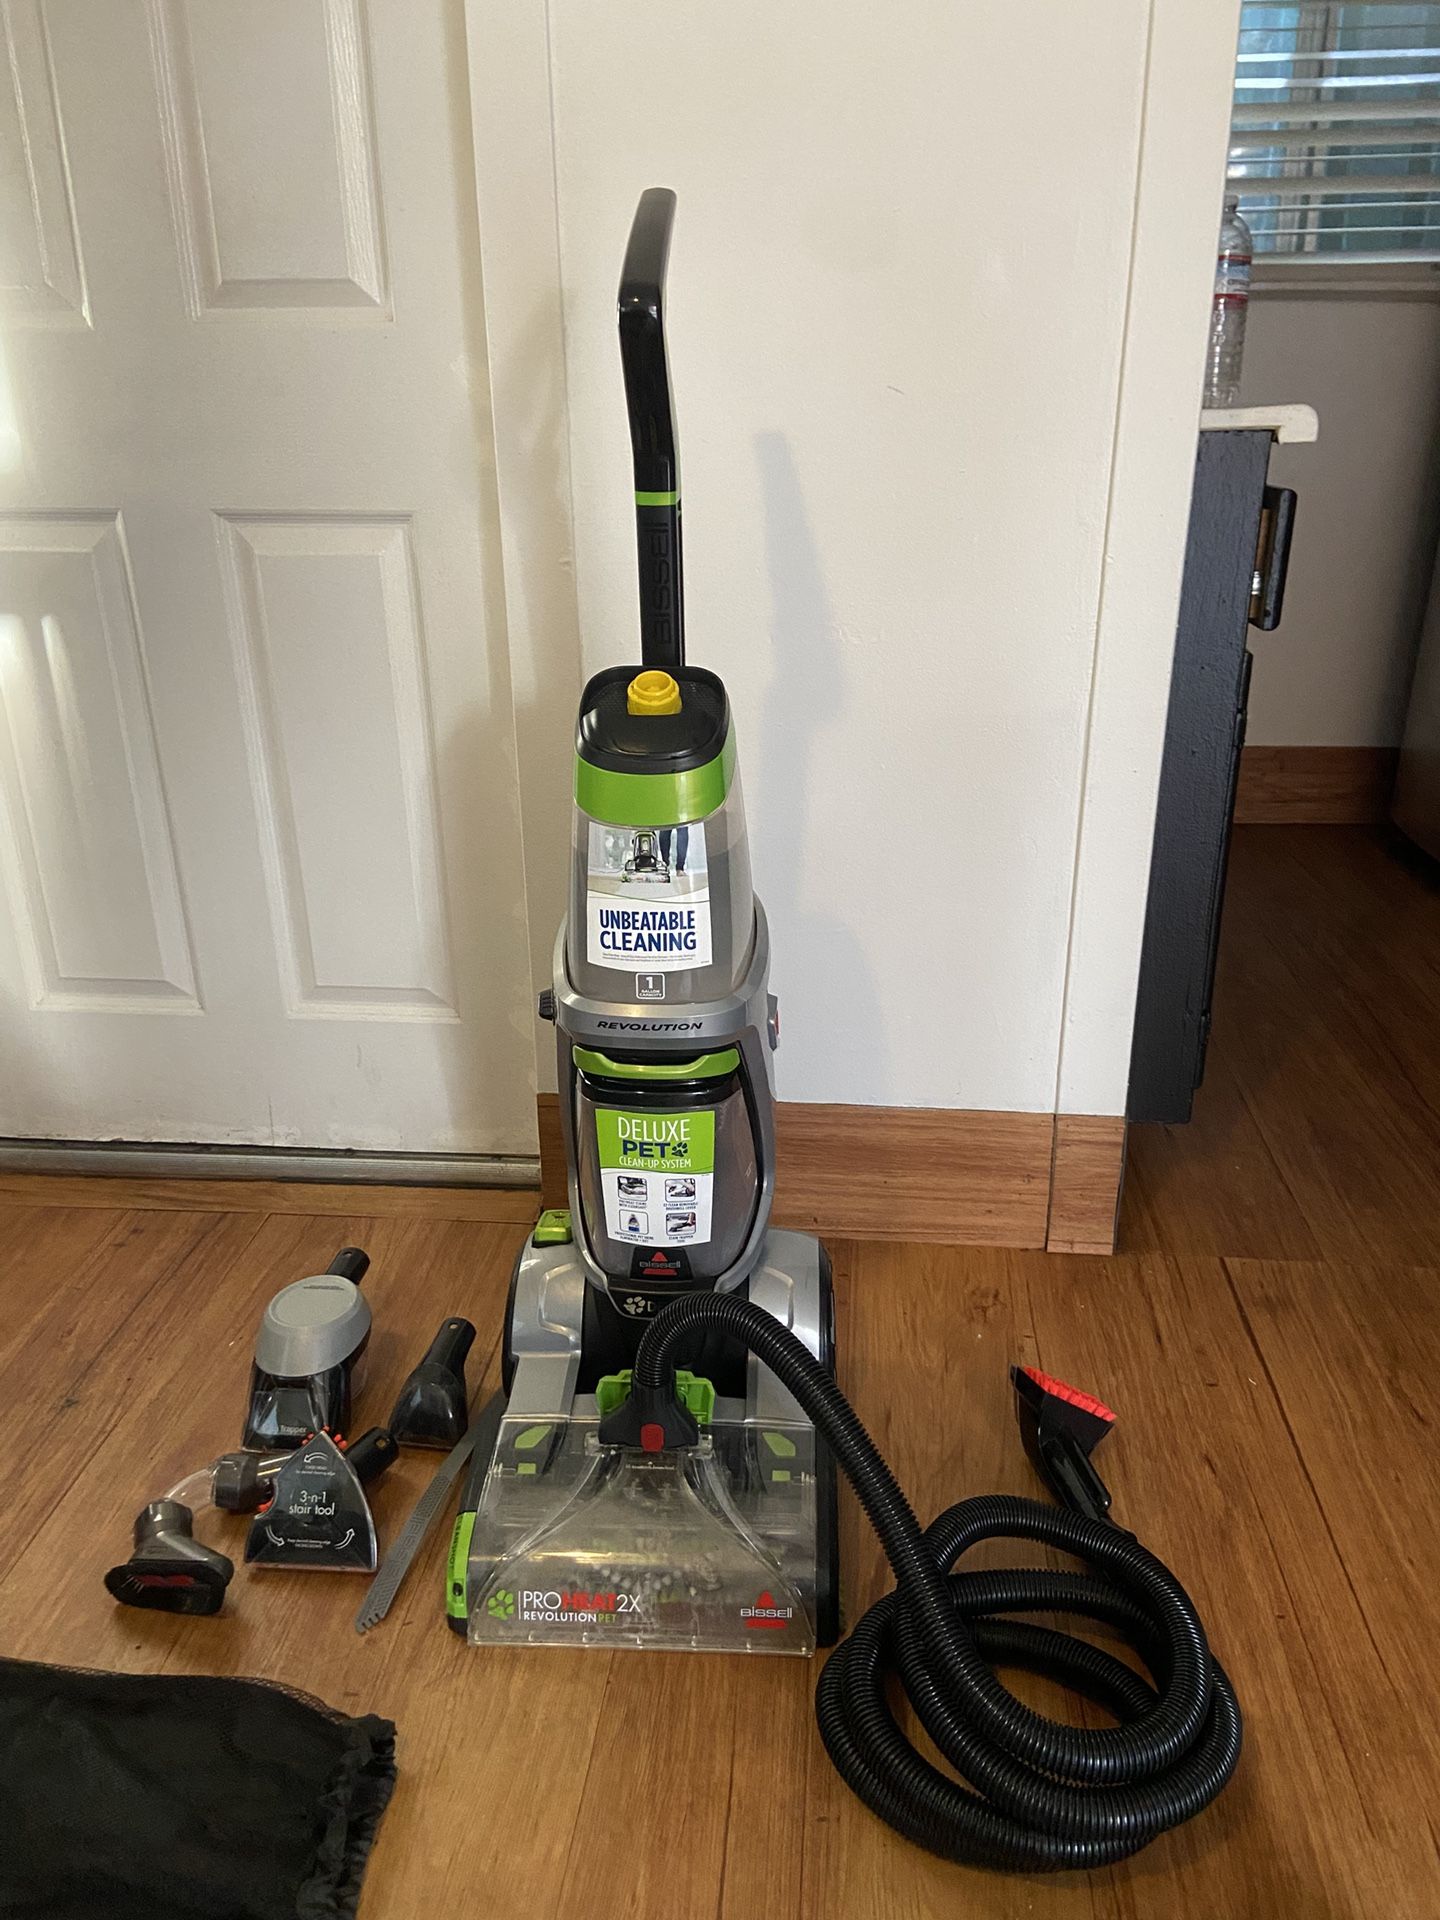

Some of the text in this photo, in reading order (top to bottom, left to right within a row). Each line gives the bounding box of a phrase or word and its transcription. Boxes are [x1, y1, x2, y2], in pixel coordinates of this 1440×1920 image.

[599, 908, 696, 931] UNBEATABLE
[599, 930, 697, 952] CLEANING
[645, 976, 653, 990] 1
[596, 1020, 704, 1032] REVOLUTION
[618, 1116, 691, 1142] DELUXE
[622, 1140, 671, 1158] PET
[619, 1156, 692, 1169] CLEAN-UP SYSTEM
[299, 1490, 327, 1503] 3-n-1
[288, 1502, 335, 1516] stair tool
